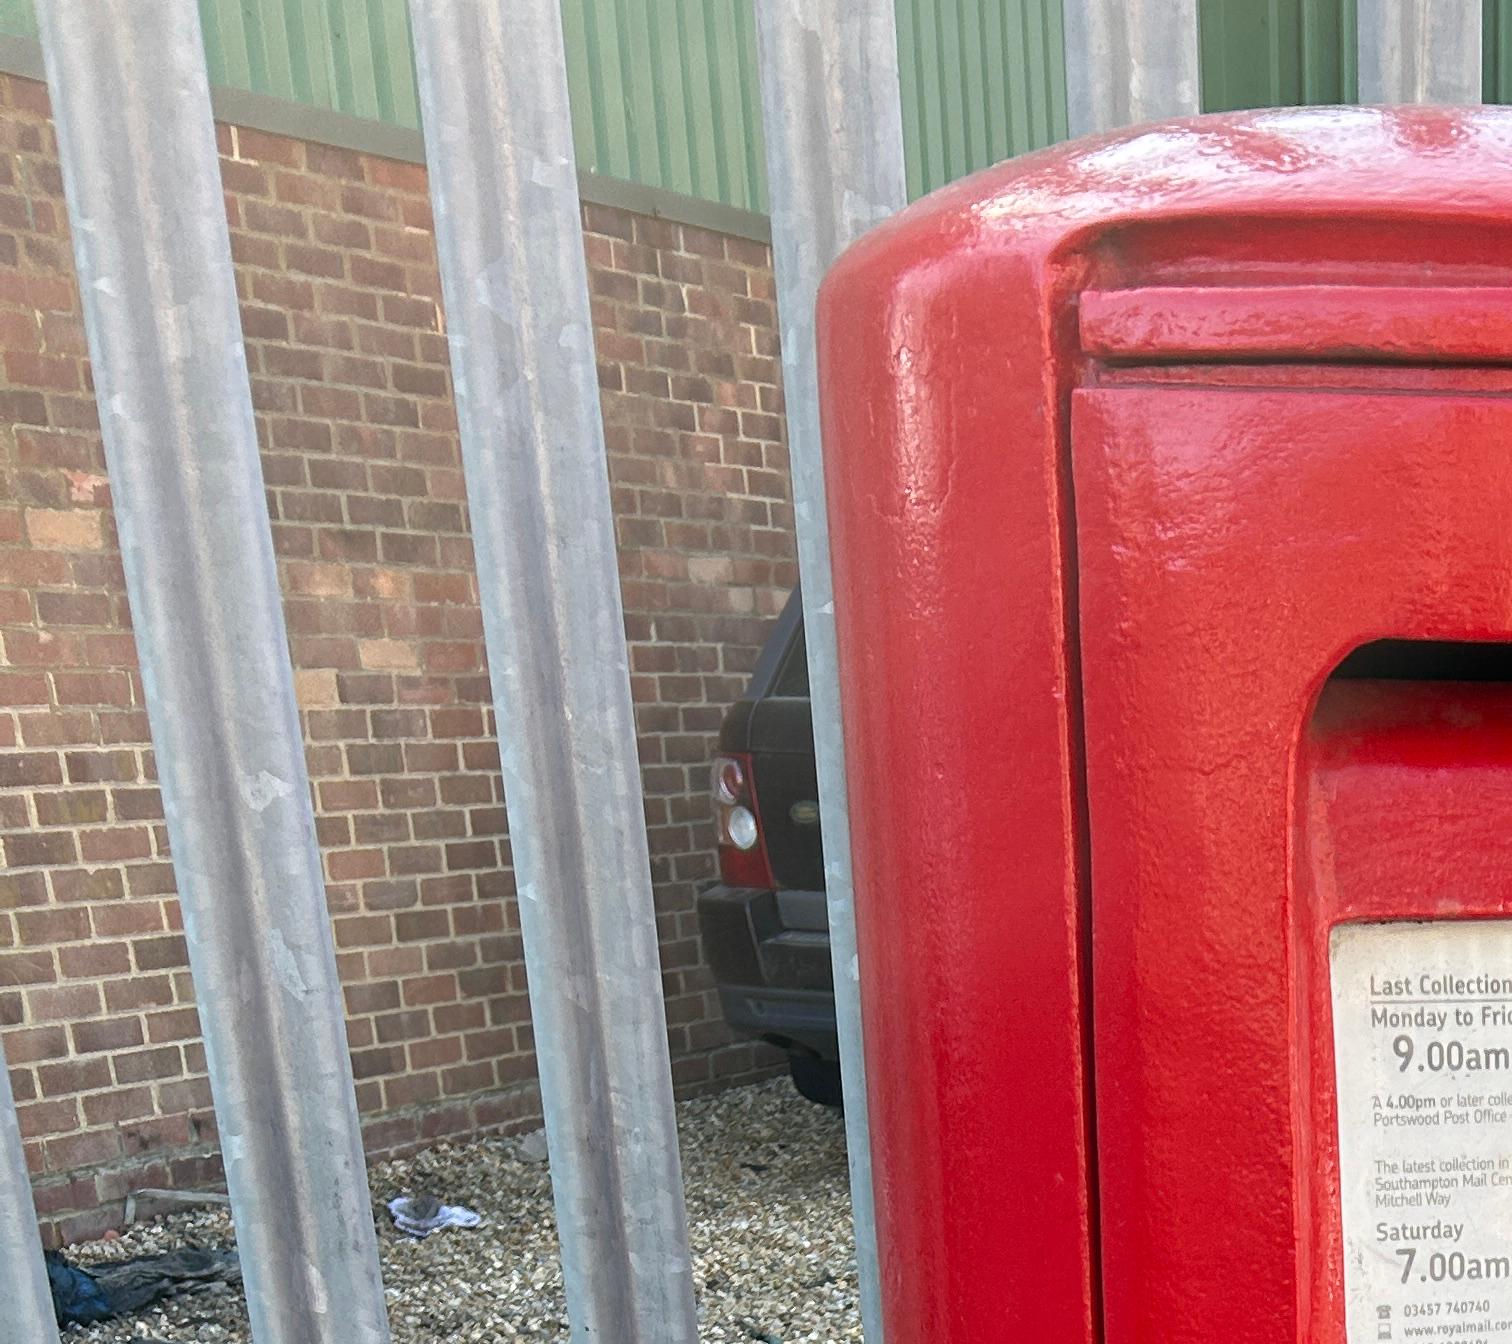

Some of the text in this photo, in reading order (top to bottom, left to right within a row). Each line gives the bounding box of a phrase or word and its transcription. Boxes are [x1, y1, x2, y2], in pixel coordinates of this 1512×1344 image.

[1370, 976, 1412, 996] Last
[1420, 974, 1512, 995] Collection
[1371, 1008, 1447, 1030] Monday
[1455, 1008, 1473, 1026] to
[1392, 1035, 1509, 1073] 9.00am
[1372, 1096, 1382, 1109] A
[1387, 1095, 1435, 1112] 4.00pm
[1440, 1096, 1453, 1107] or
[1457, 1093, 1483, 1106] later
[1374, 1110, 1507, 1127] Portswood Post Office
[1375, 1160, 1398, 1174] The
[1403, 1159, 1436, 1173] latest
[1440, 1157, 1494, 1172] collection
[1499, 1155, 1508, 1168] in
[1375, 1174, 1458, 1191] Southampton
[1463, 1173, 1487, 1186] Mail
[1375, 1193, 1451, 1208] Mitchell Way
[1376, 1221, 1463, 1242] Saturday
[1396, 1248, 1510, 1284] 7.00am
[1404, 1300, 1490, 1317] 03457 740740
